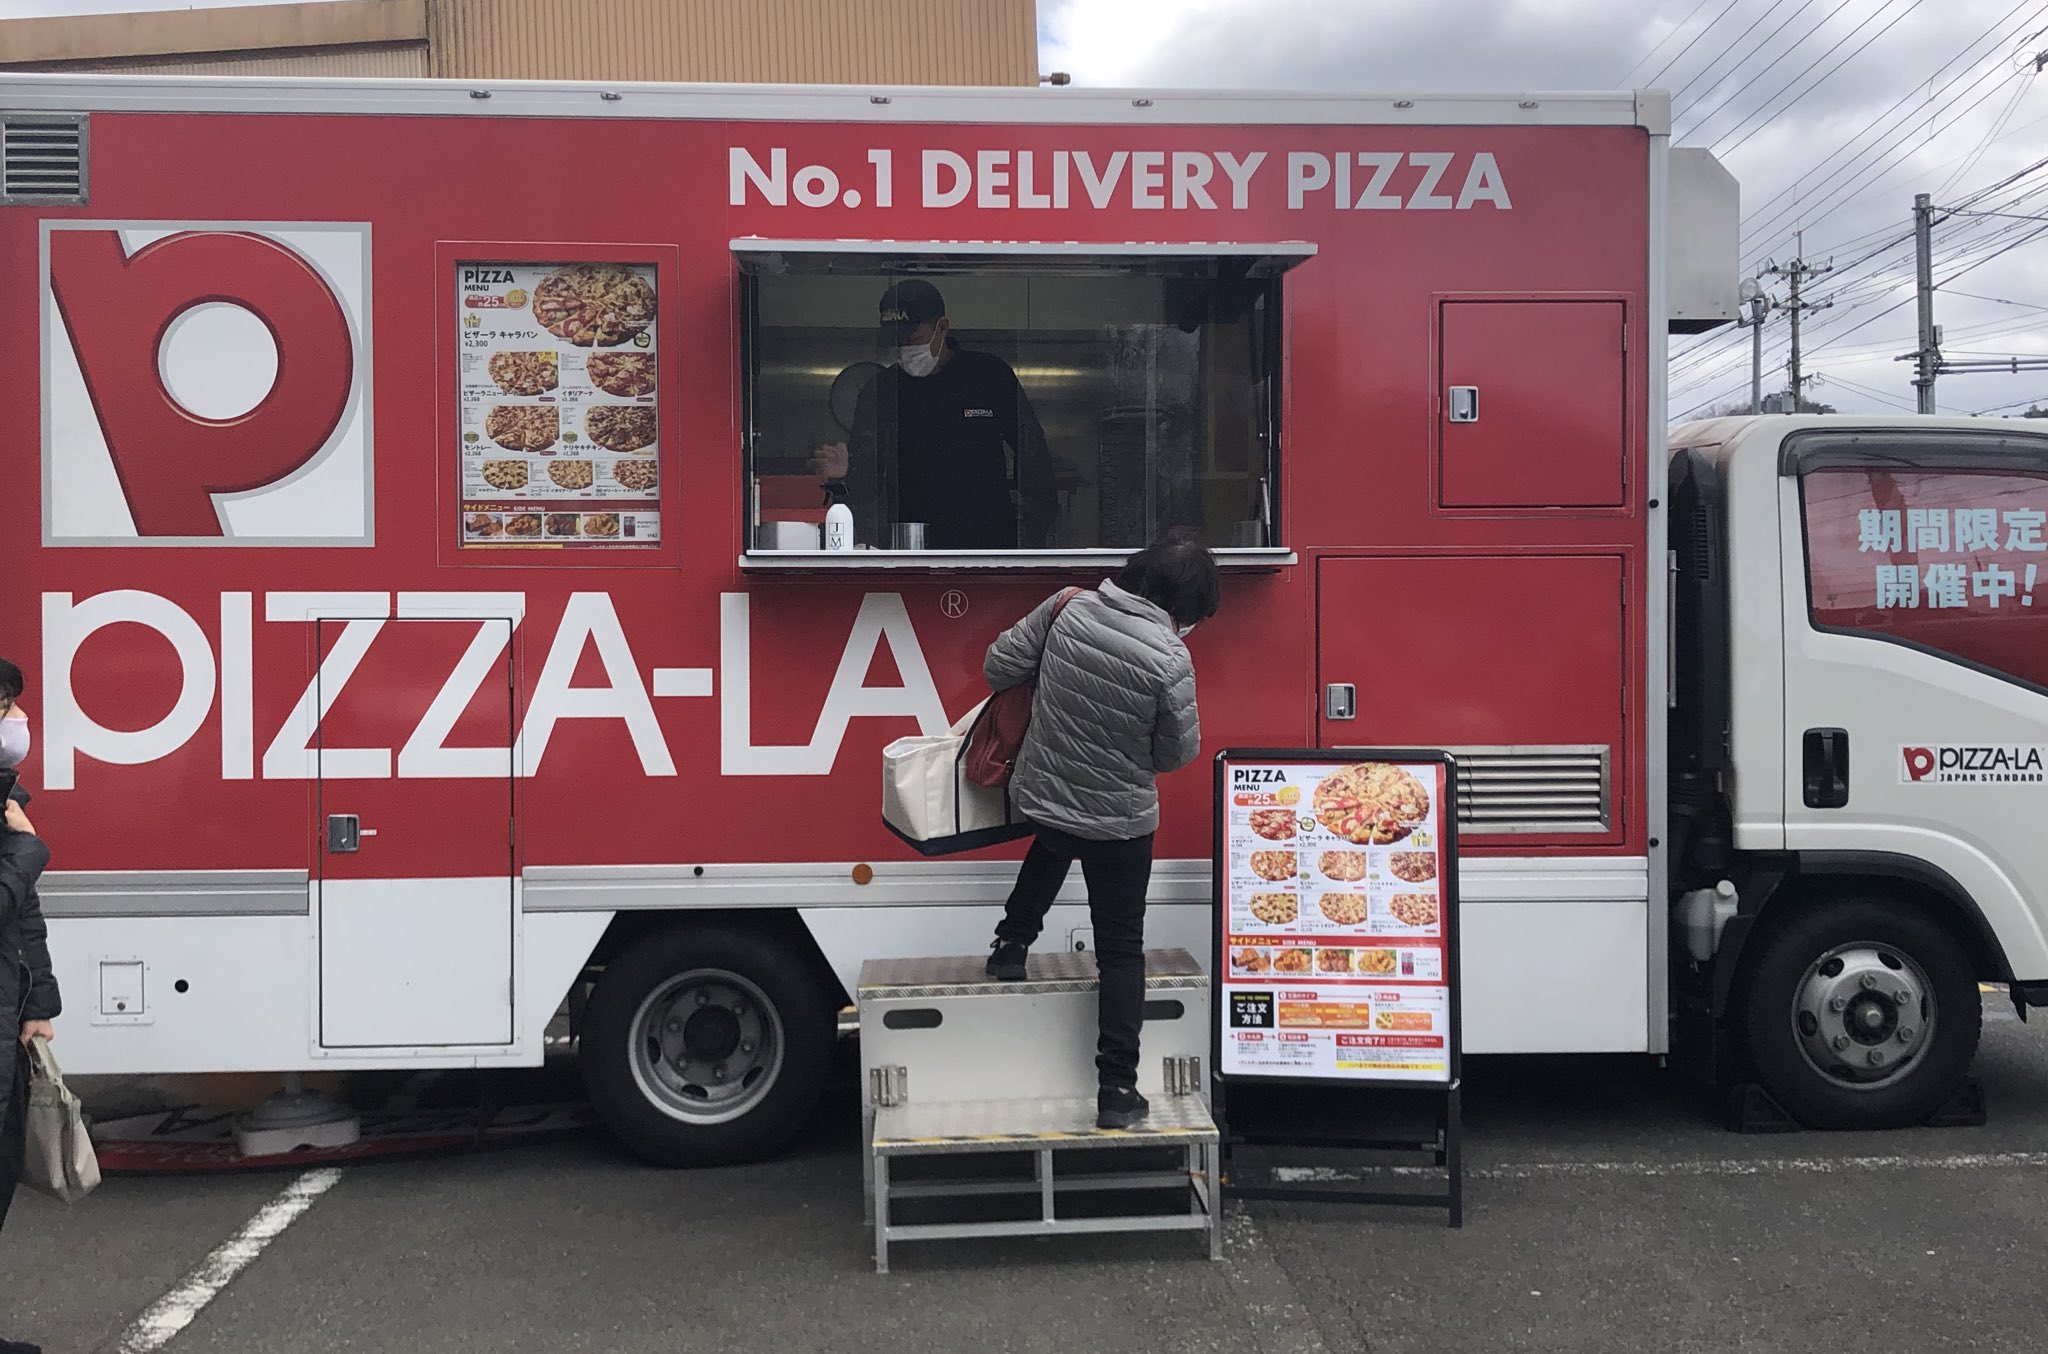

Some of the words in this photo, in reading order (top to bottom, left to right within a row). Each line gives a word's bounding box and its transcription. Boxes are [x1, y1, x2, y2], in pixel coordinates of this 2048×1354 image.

[730, 148, 892, 208] No.1
[922, 149, 1268, 209] DELIVERY
[1288, 151, 1513, 209] PIZZA
[464, 270, 515, 283] PIZZA
[1858, 507, 2048, 552] 期間限定
[1876, 564, 2038, 609] 開催中!
[1234, 770, 1286, 782] PIZZA
[1940, 774, 1976, 782] JAPAN
[1981, 774, 2043, 782] STANDARD
[1230, 937, 1279, 945] サイドメニュー
[1237, 1003, 1267, 1013] ご注文
[1242, 1014, 1262, 1024] 方法
